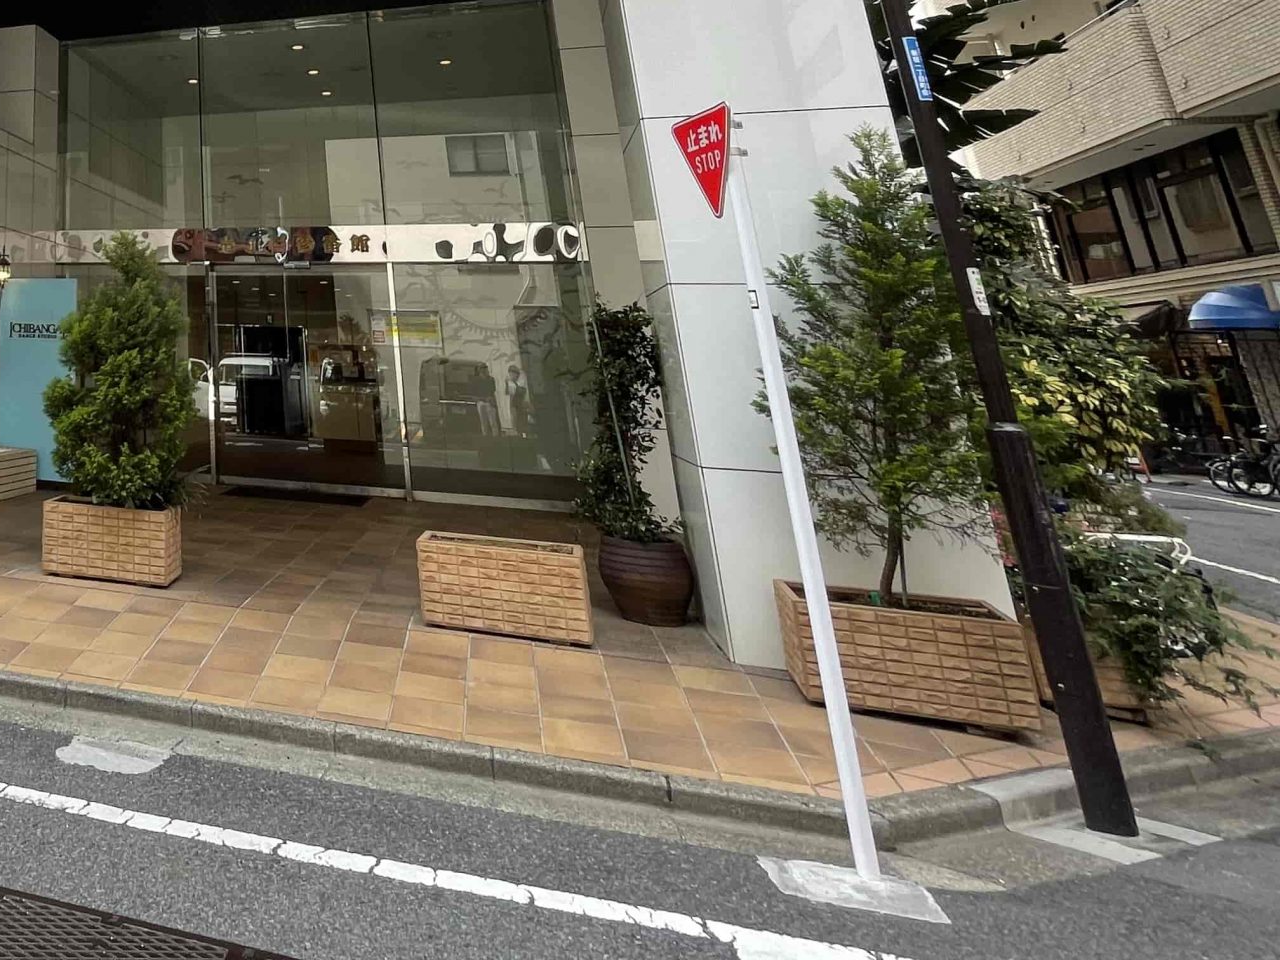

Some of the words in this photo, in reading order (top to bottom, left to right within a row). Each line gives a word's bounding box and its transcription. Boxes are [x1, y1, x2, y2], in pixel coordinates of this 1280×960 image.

[686, 120, 722, 152] 止まれ
[695, 149, 721, 174] STOP
